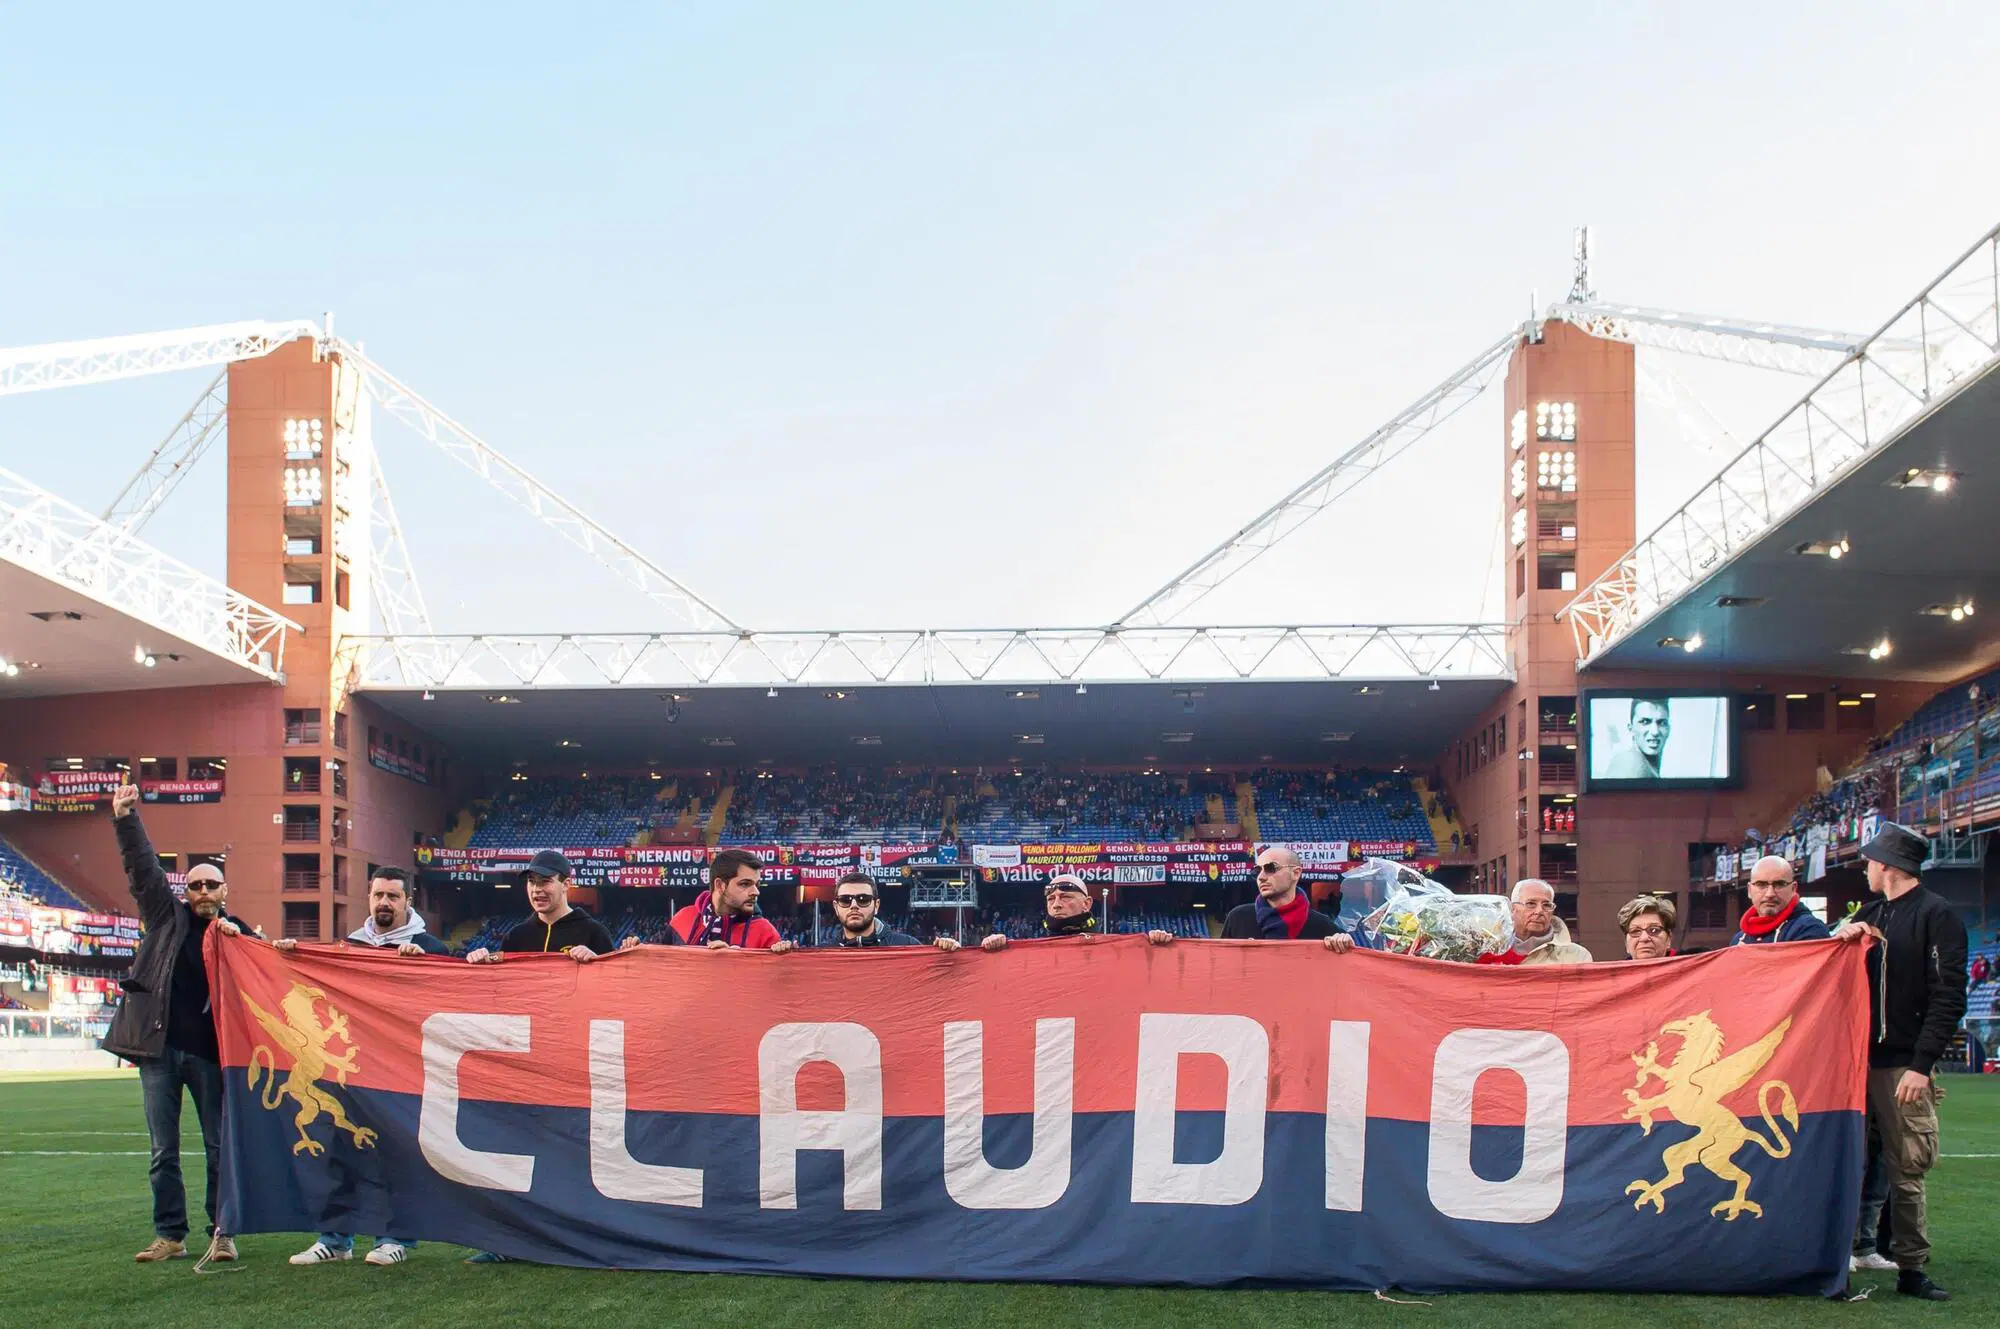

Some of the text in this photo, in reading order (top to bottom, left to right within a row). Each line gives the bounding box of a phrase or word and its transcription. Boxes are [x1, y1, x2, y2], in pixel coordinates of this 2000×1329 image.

[58, 783, 100, 794] RAPALLO
[159, 782, 219, 792] GENOA CLUB
[816, 846, 852, 857] HONG
[1022, 846, 1045, 854] GENOA
[1046, 846, 1064, 854] CLUB
[1105, 845, 1135, 853] GENOA
[1175, 843, 1244, 852] GENOA CLUB
[1317, 843, 1342, 851] CLUB
[433, 848, 496, 859] GENOA CLUB
[564, 850, 586, 858] GENOA
[592, 848, 613, 858] ASTI
[636, 849, 692, 863] MERANO
[1296, 851, 1336, 860] CEANIA
[815, 856, 851, 867] KONG
[907, 857, 938, 865] ALASKA
[1109, 854, 1168, 862] MONTEROSSO
[1187, 854, 1229, 862] LEVANTO
[580, 868, 605, 876] CLUB
[620, 867, 699, 876] GENOA CLUB
[1000, 864, 1044, 882] Valle
[1116, 866, 1154, 881] TRENTO
[450, 871, 485, 882] PEGLI
[624, 878, 699, 886] MONTECARLO
[418, 1011, 1570, 1225] CLAUDIO
